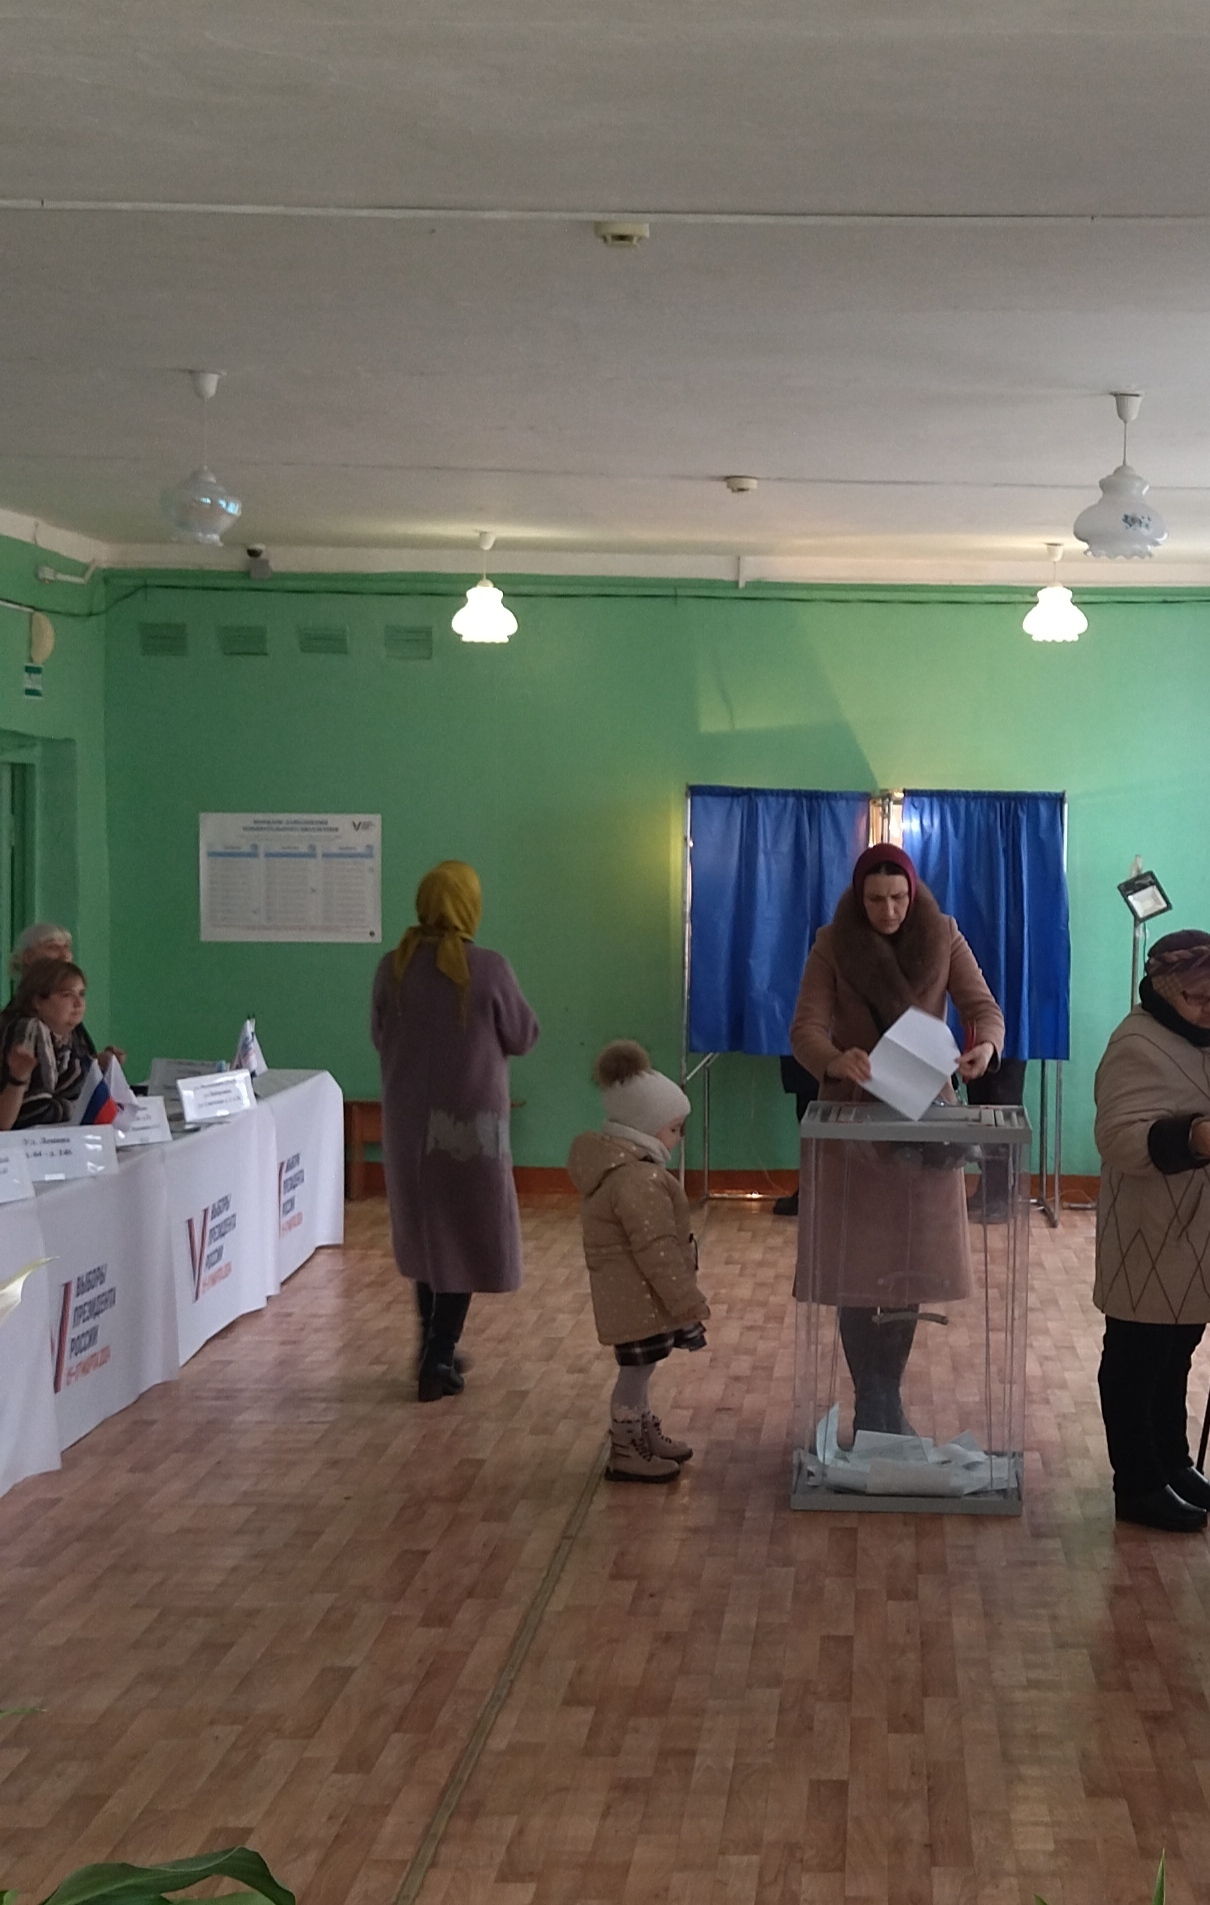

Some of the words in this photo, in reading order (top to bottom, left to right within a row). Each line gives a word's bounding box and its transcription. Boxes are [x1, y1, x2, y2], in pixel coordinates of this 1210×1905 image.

[76, 1263, 108, 1298] ВЫБОРЫ
[72, 1286, 117, 1329] ПРЕЗИДЕНТА
[69, 1324, 99, 1359] РОССИИ
